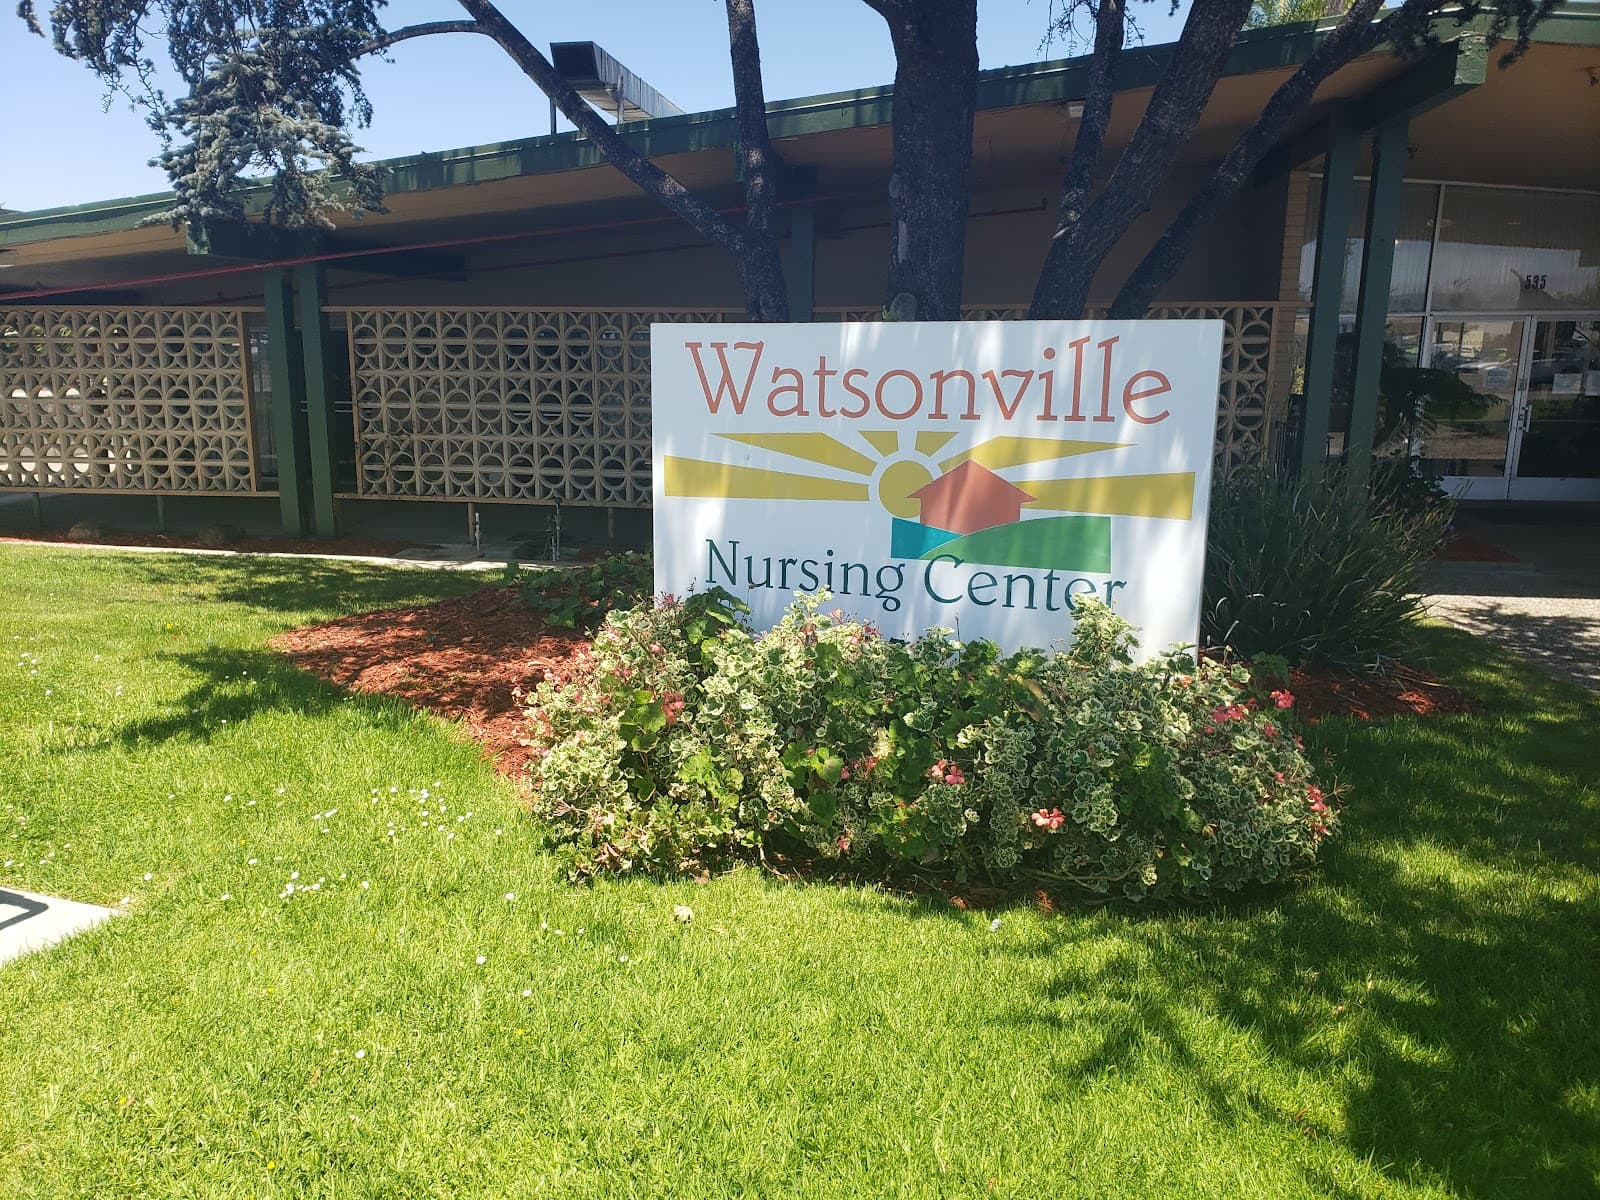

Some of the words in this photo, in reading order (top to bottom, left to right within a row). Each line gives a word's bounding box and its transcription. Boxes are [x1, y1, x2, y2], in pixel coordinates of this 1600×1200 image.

[1524, 274, 1547, 290] 535
[685, 336, 1172, 424] Watsonville
[705, 538, 905, 612] Nursing
[923, 554, 1127, 612] Center
